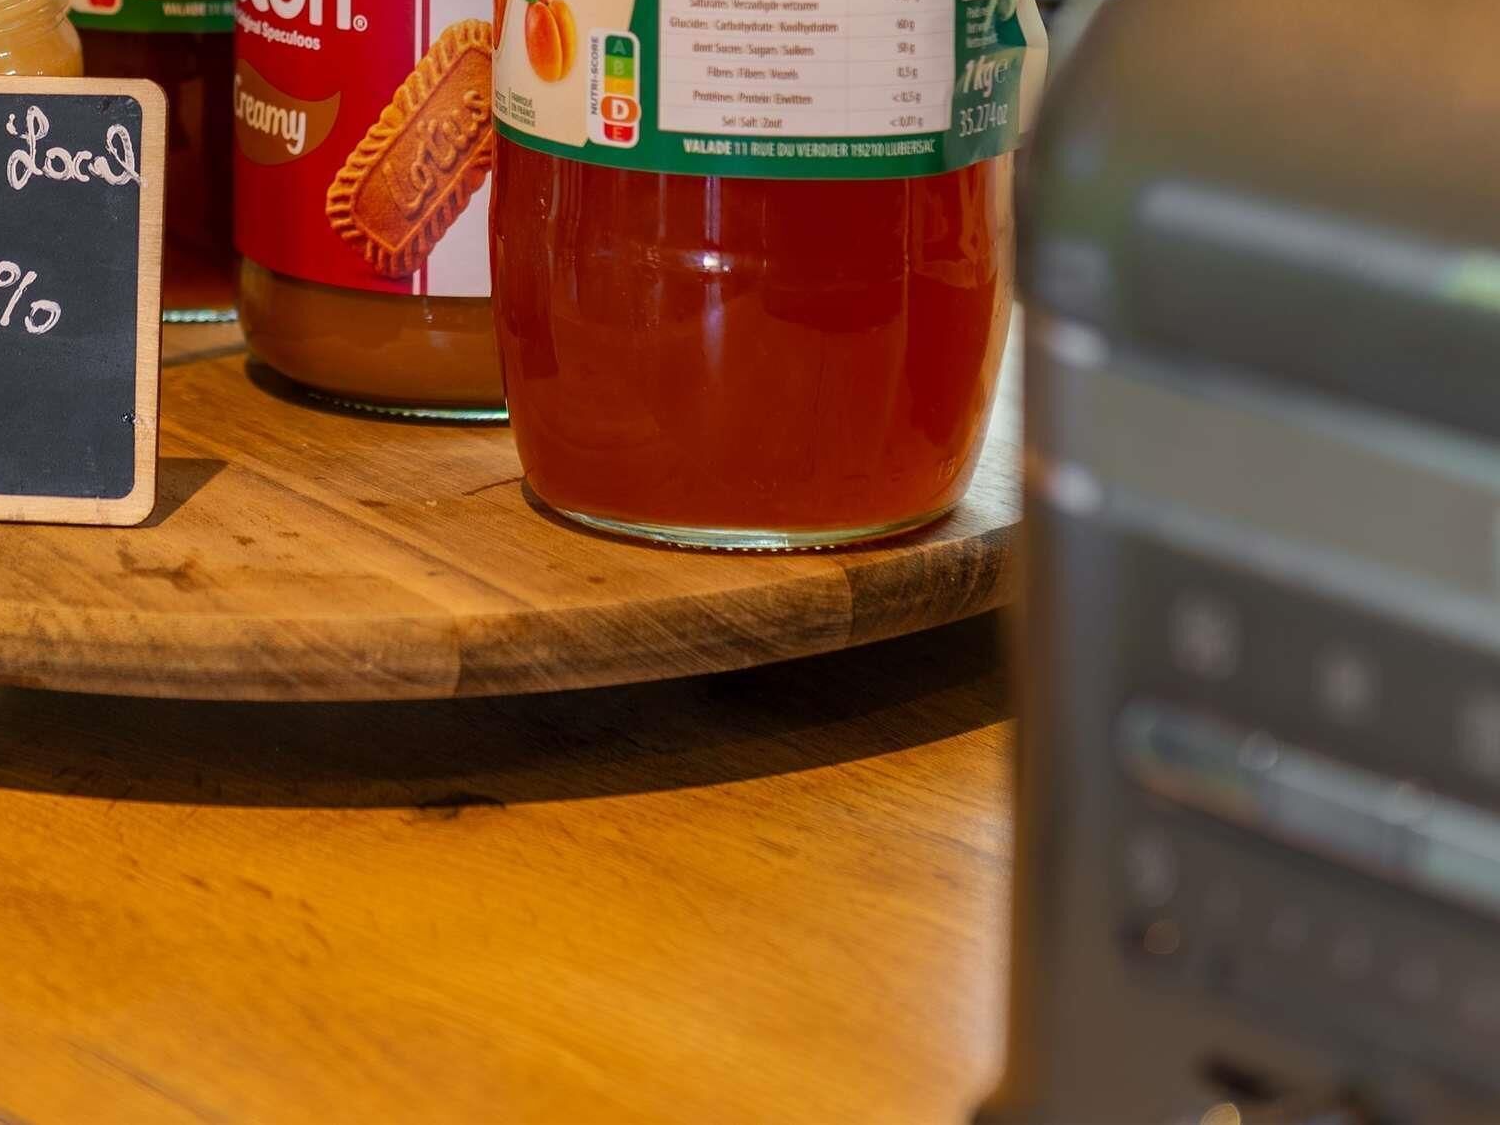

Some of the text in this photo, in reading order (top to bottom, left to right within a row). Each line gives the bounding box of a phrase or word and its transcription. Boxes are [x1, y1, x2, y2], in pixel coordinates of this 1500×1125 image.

[261, 21, 321, 51] Speculoos
[590, 36, 599, 115] NUTRI-SCORE
[234, 73, 307, 155] Creamy
[612, 99, 630, 121] D
[6, 105, 143, 190] Local
[683, 138, 732, 154] VALADE
[734, 140, 748, 155] 11
[751, 140, 775, 156] RUE
[777, 141, 795, 156] DU
[797, 142, 849, 157] VERDIER
